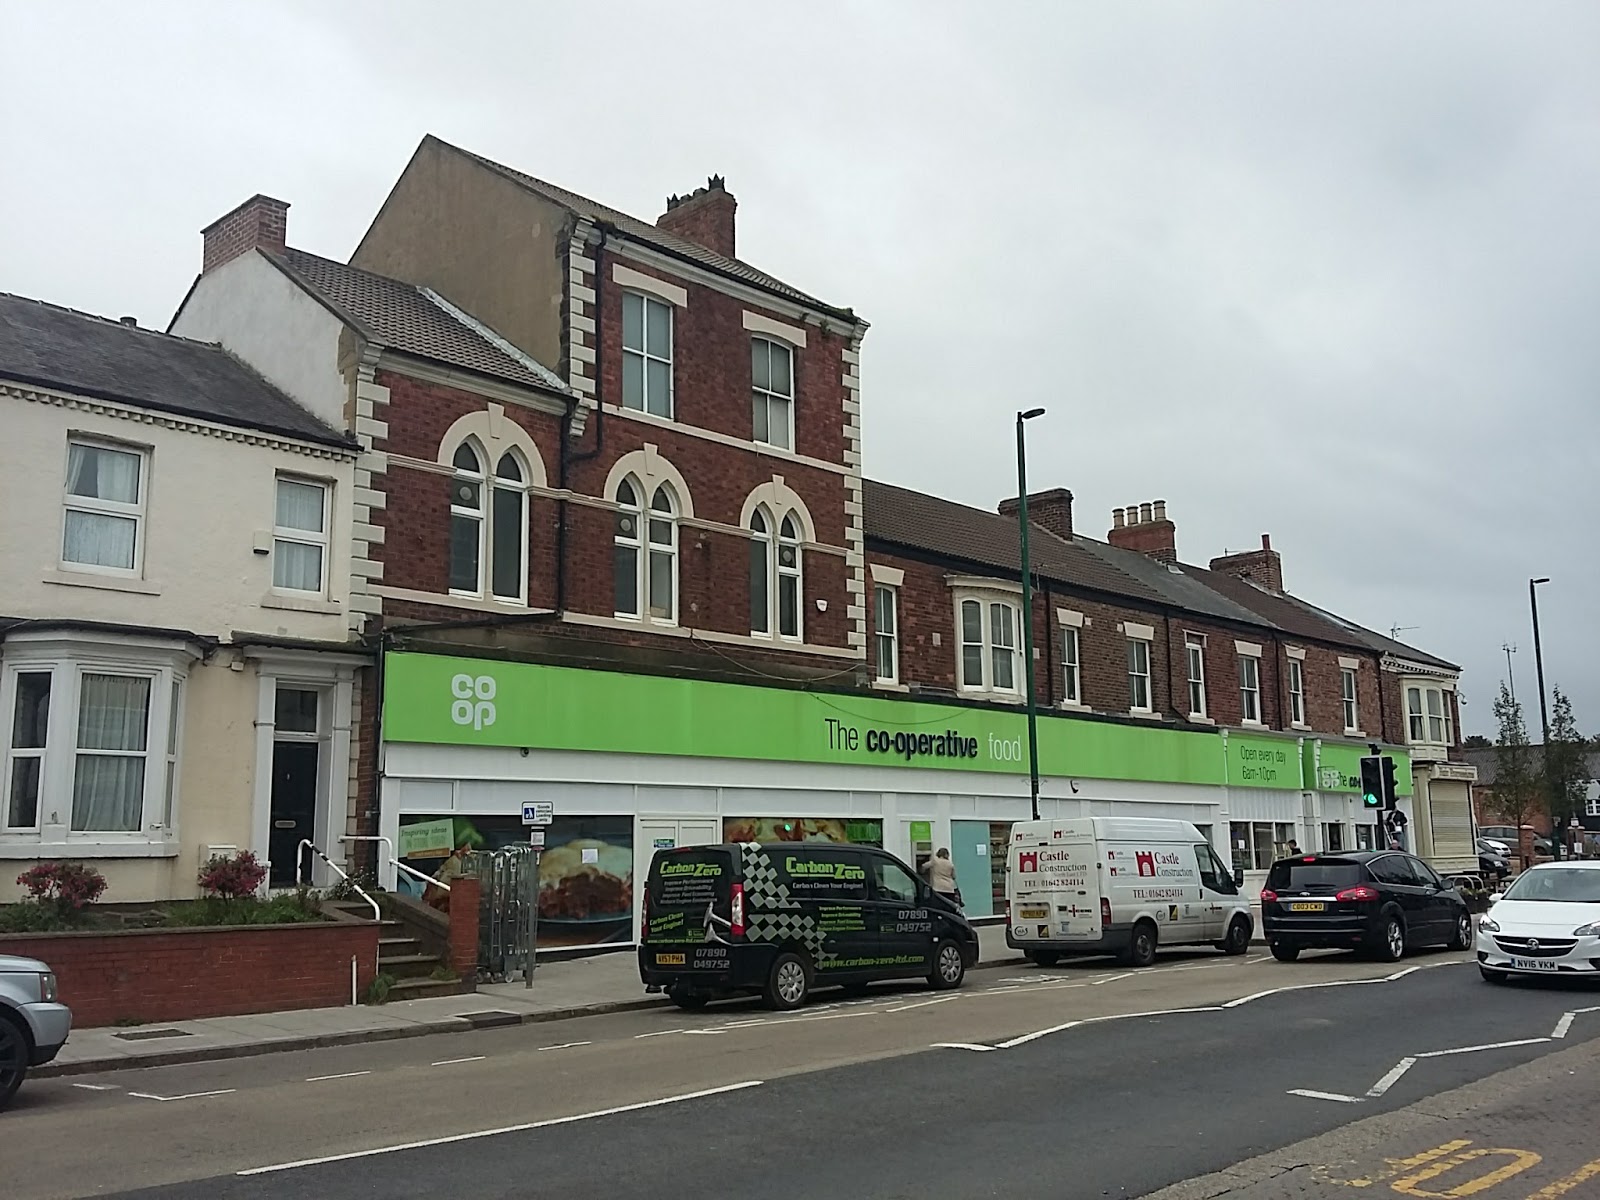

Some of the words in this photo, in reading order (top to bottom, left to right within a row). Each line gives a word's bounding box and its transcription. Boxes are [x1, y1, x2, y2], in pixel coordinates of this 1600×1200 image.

[825, 718, 858, 751] The
[866, 729, 978, 760] co-operative
[988, 732, 1022, 762] food
[1240, 745, 1257, 764] Open
[1258, 750, 1275, 765] every
[1276, 749, 1286, 765] day
[1242, 766, 1276, 782] 6am-10pm
[1338, 772, 1346, 786] he
[401, 829, 430, 838] Inspiring
[1040, 850, 1070, 861] Castle
[1154, 852, 1179, 865] Castle
[660, 861, 694, 874] Carbon
[693, 863, 722, 876] Zero
[786, 856, 834, 873] Carbon
[834, 864, 865, 879] Zero
[1039, 864, 1087, 873] Construction
[1156, 866, 1193, 877] Construction
[1149, 889, 1164, 898] 01642
[1165, 889, 1183, 897] 824114
[898, 910, 928, 920] 07890
[650, 917, 668, 926] Carbon
[663, 919, 684, 929] Engine!
[896, 923, 931, 932] 049752
[696, 948, 726, 957] 07890
[694, 960, 730, 968] 049752
[822, 955, 925, 968] www.carbon-zero-ltd.com
[1518, 959, 1536, 968] NV16
